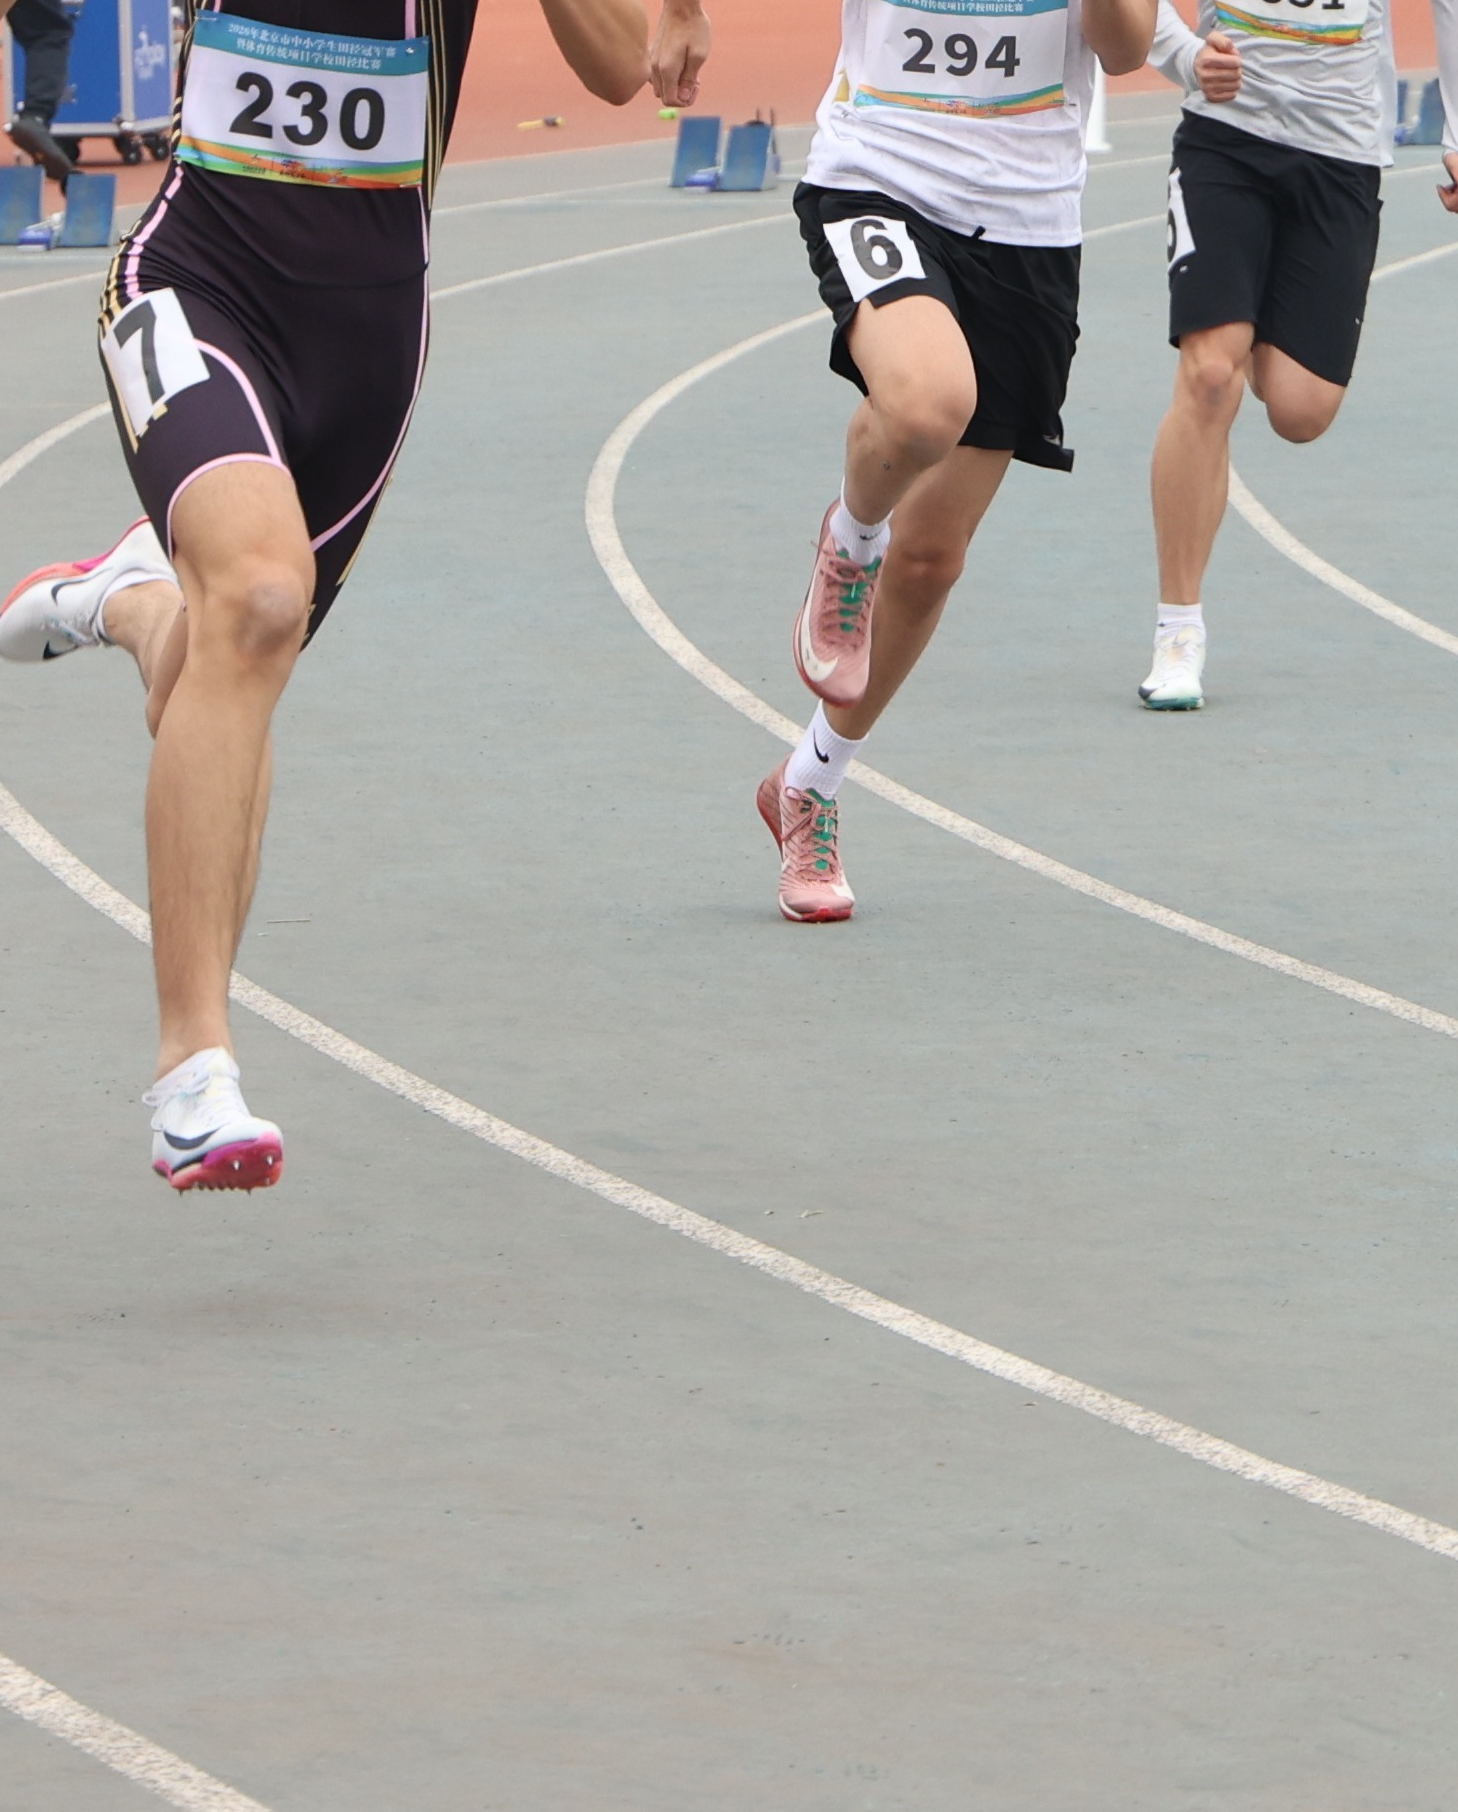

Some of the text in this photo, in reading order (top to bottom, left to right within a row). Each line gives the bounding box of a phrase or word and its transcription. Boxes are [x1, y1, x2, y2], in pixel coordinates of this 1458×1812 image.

[902, 28, 1021, 77] 294
[229, 71, 386, 151] 230
[850, 219, 903, 280] 6
[112, 299, 166, 405] 7
